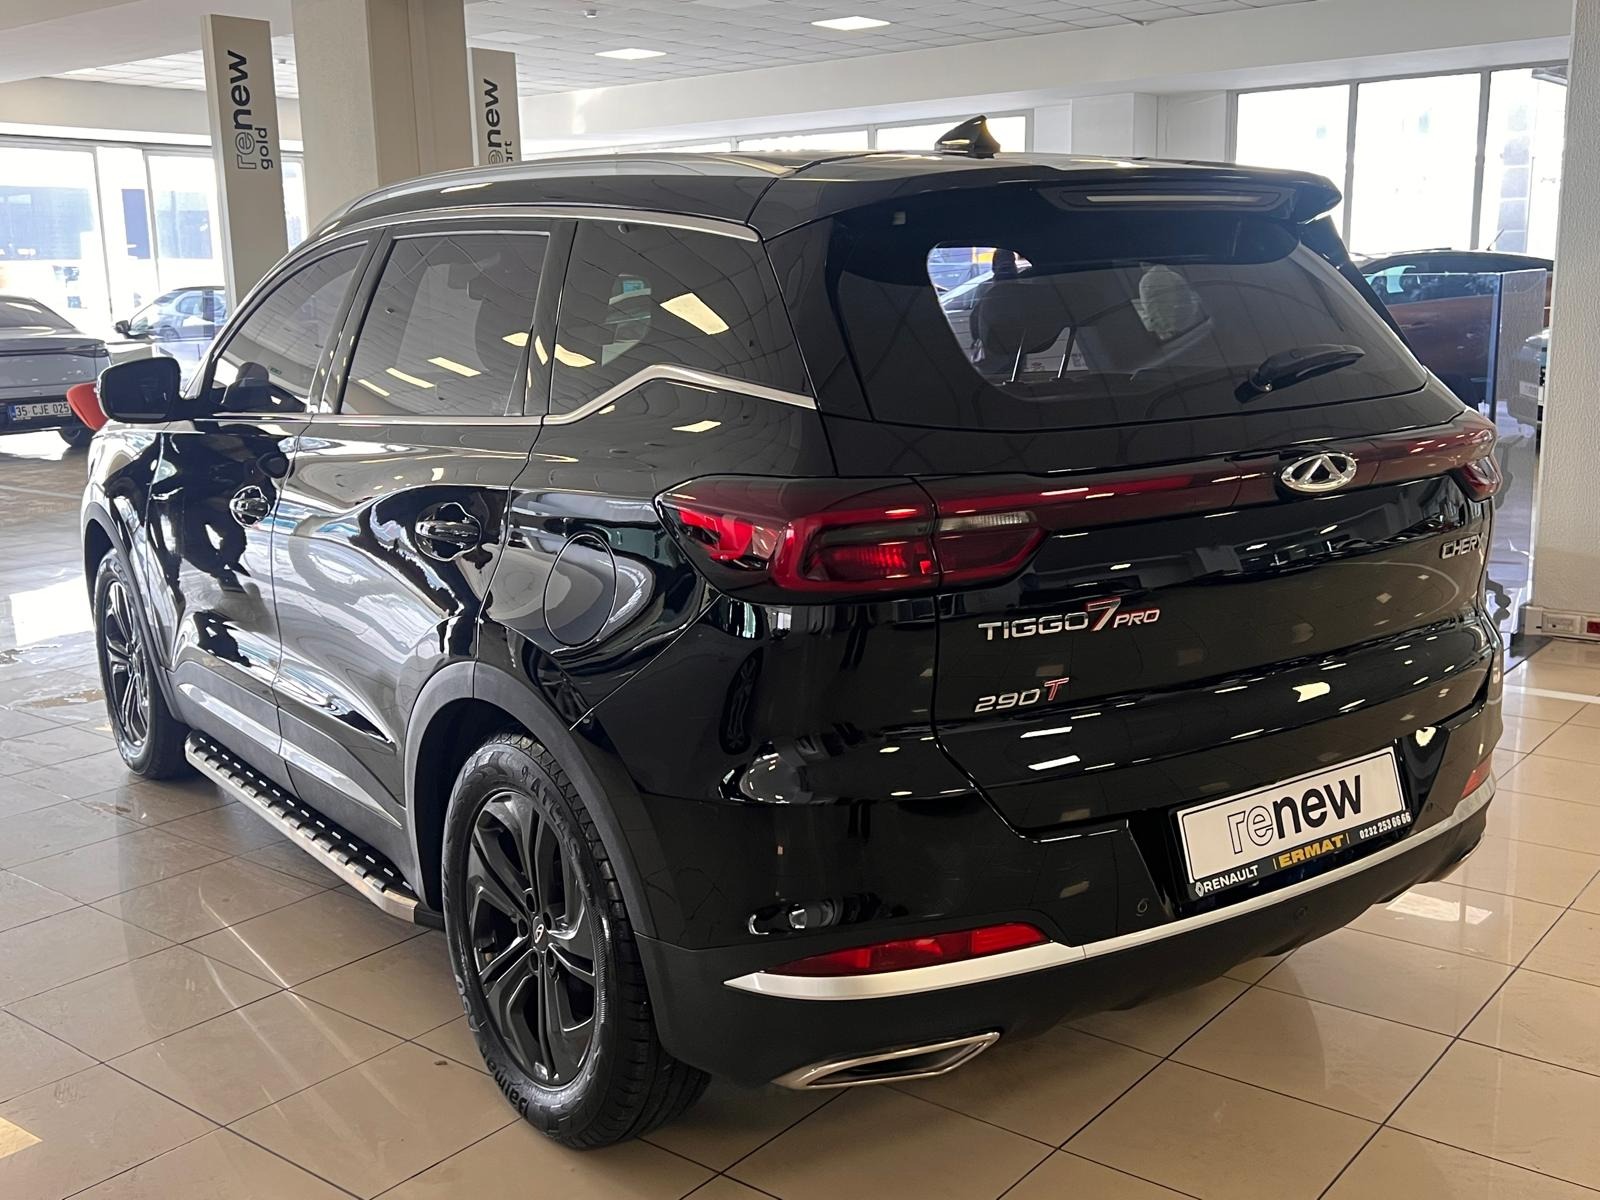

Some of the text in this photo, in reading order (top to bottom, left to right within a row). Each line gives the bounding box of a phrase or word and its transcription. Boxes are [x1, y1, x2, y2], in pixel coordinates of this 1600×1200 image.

[227, 50, 257, 170] renew
[483, 77, 504, 165] enew
[255, 127, 273, 170] gold
[504, 140, 514, 163] art
[15, 402, 71, 417] 35 CJE 025
[1441, 532, 1484, 559] CHERY
[1226, 774, 1362, 855] renew
[1204, 811, 1412, 893] RENAULT ERMAT 0232 253 66 66
